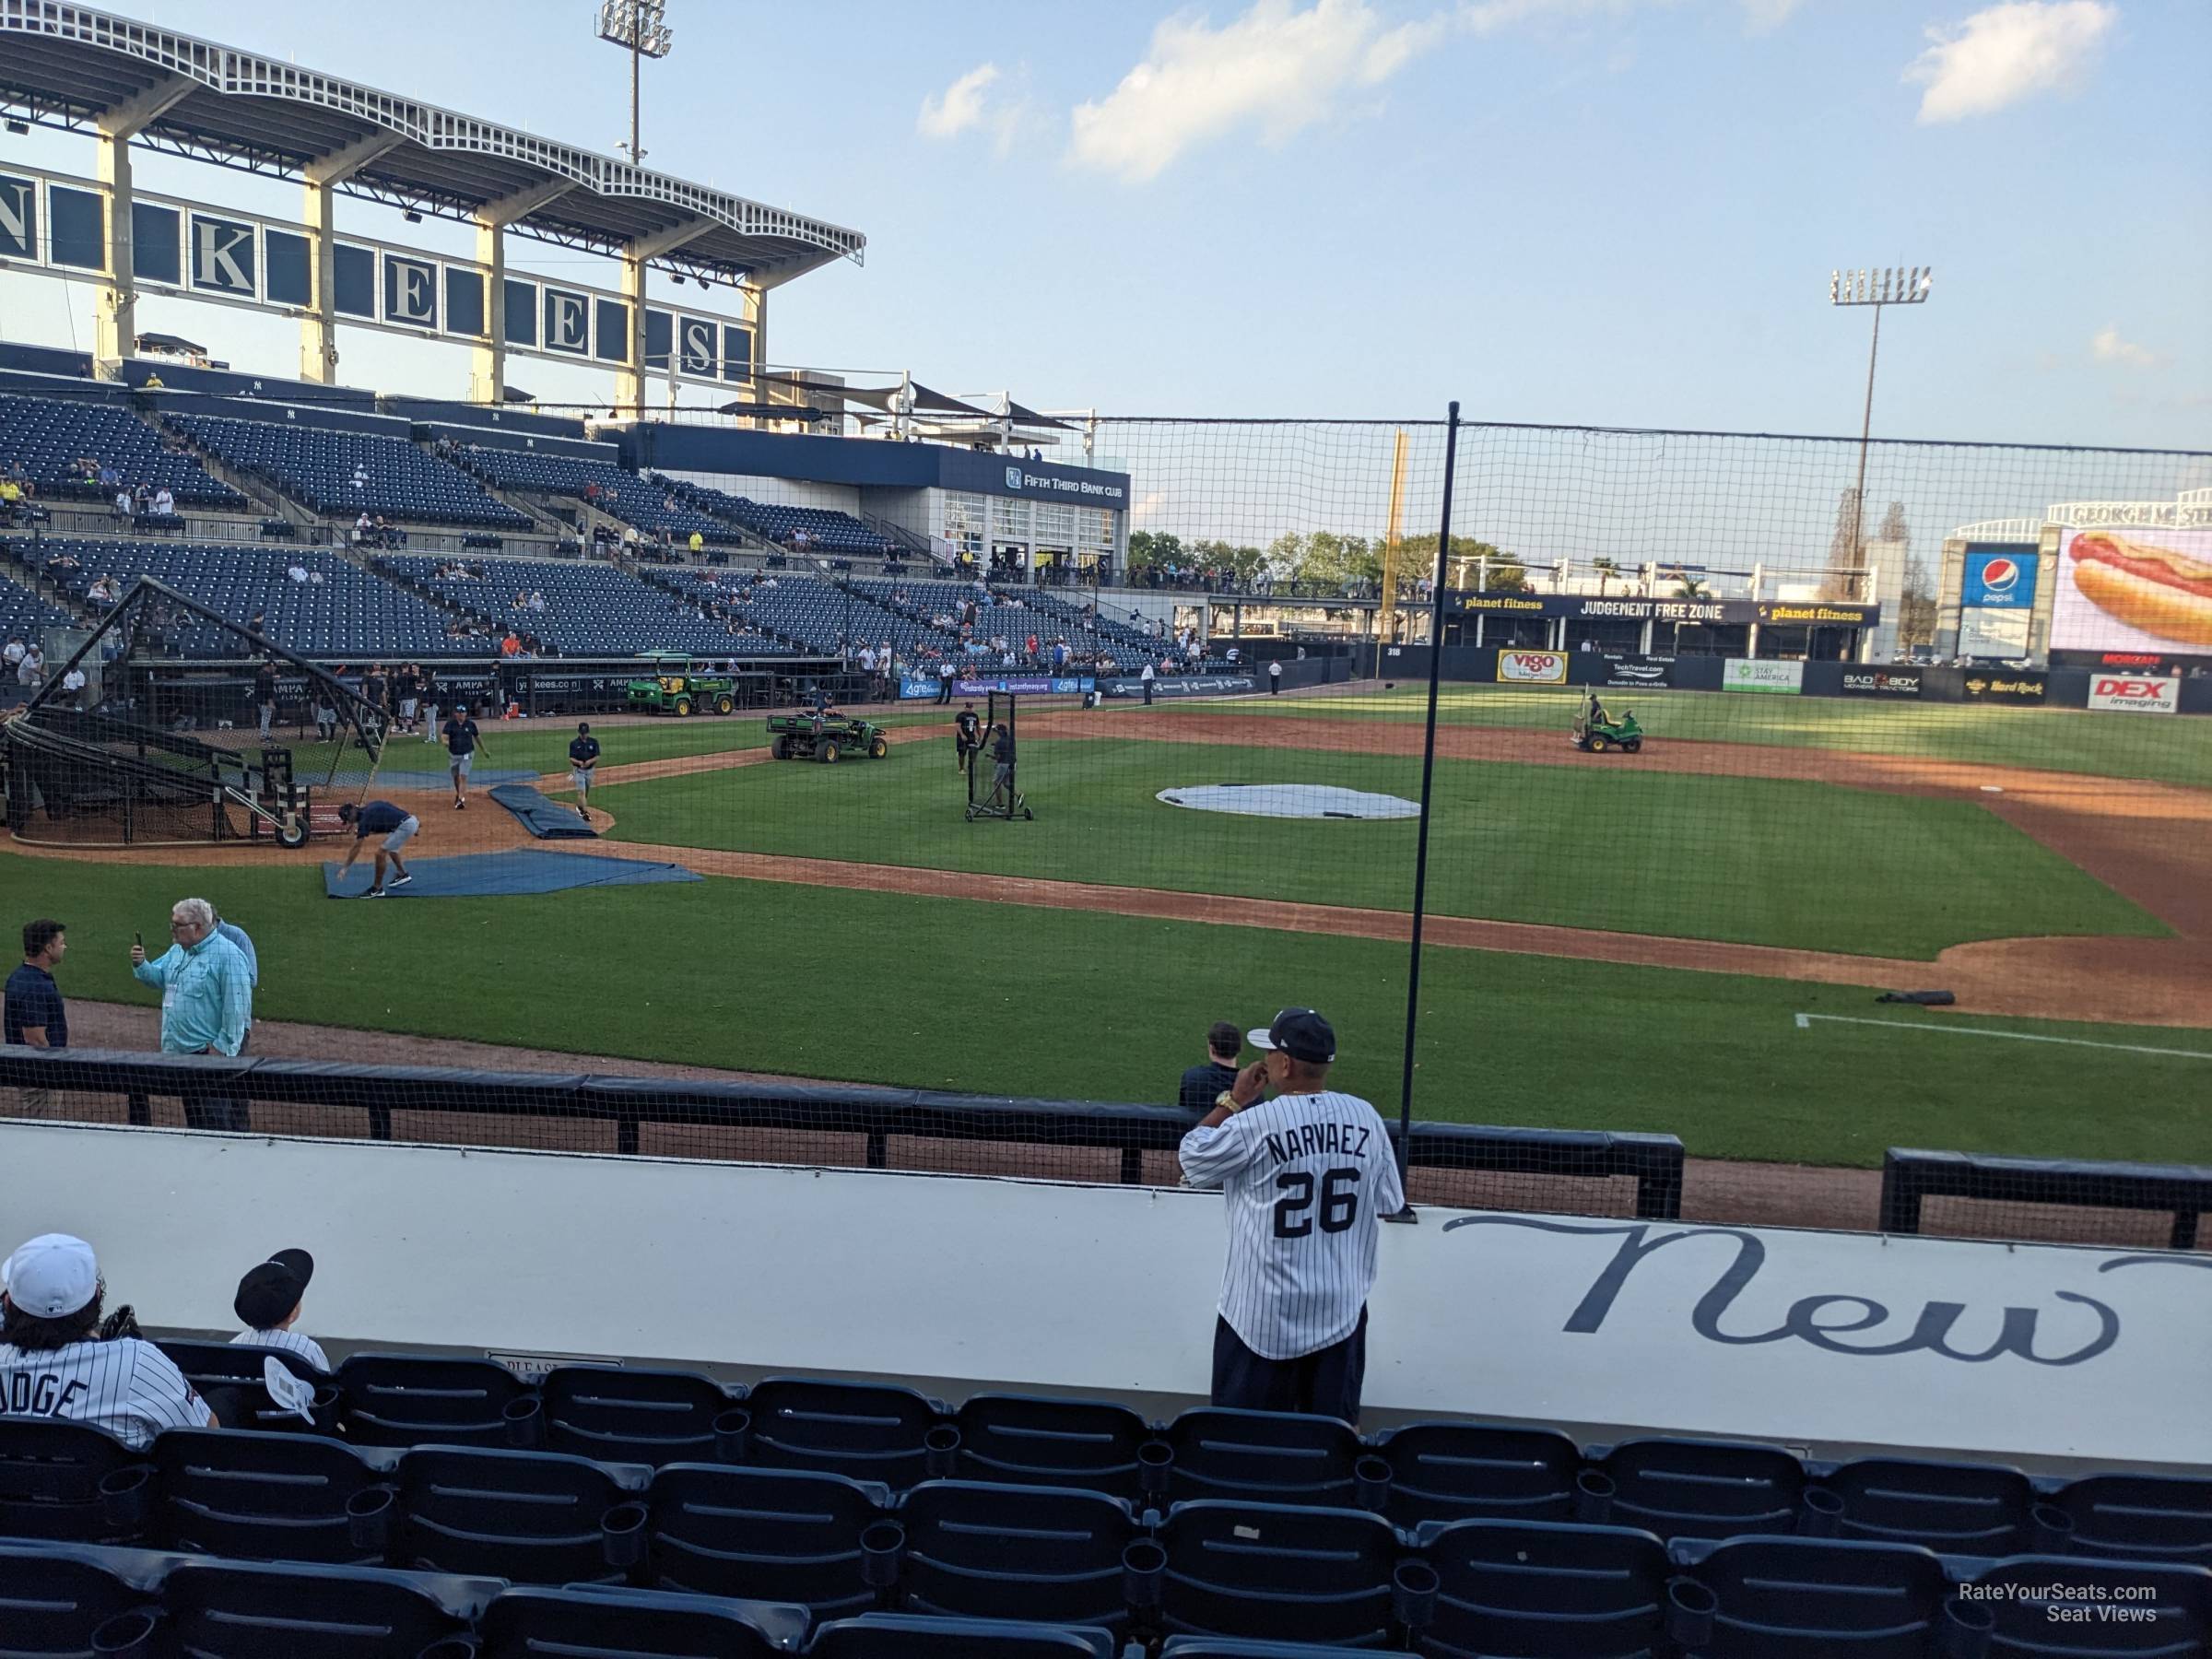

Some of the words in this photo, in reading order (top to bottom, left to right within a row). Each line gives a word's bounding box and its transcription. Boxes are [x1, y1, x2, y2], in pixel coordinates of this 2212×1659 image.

[1024, 475, 1051, 488] FIFTH
[1052, 478, 1079, 492] THIRD
[1080, 482, 1104, 495] BANK
[1105, 488, 1123, 498] CLUB
[1465, 597, 1502, 610] planet
[1503, 597, 1543, 610] fitness
[1983, 594, 2015, 604] pepsi
[1580, 600, 1653, 617] JUDGEMENT
[1654, 603, 1687, 618] FREE
[1688, 605, 1724, 619] ZONE
[1771, 608, 1815, 621] planet
[1817, 608, 1863, 622] fitness
[1387, 647, 1401, 656] 318
[1614, 664, 1664, 673] TechTravel.com
[1844, 675, 1873, 684] BAD
[1888, 677, 1919, 687] BOY
[1990, 680, 2016, 692] Hard
[2017, 682, 2042, 695] Rock
[2094, 679, 2168, 699] DEX
[2110, 697, 2171, 709] imaging
[1265, 1124, 1371, 1165] NARVAEZ
[1274, 1167, 1361, 1238] 26
[508, 1361, 558, 1372] PLEAS
